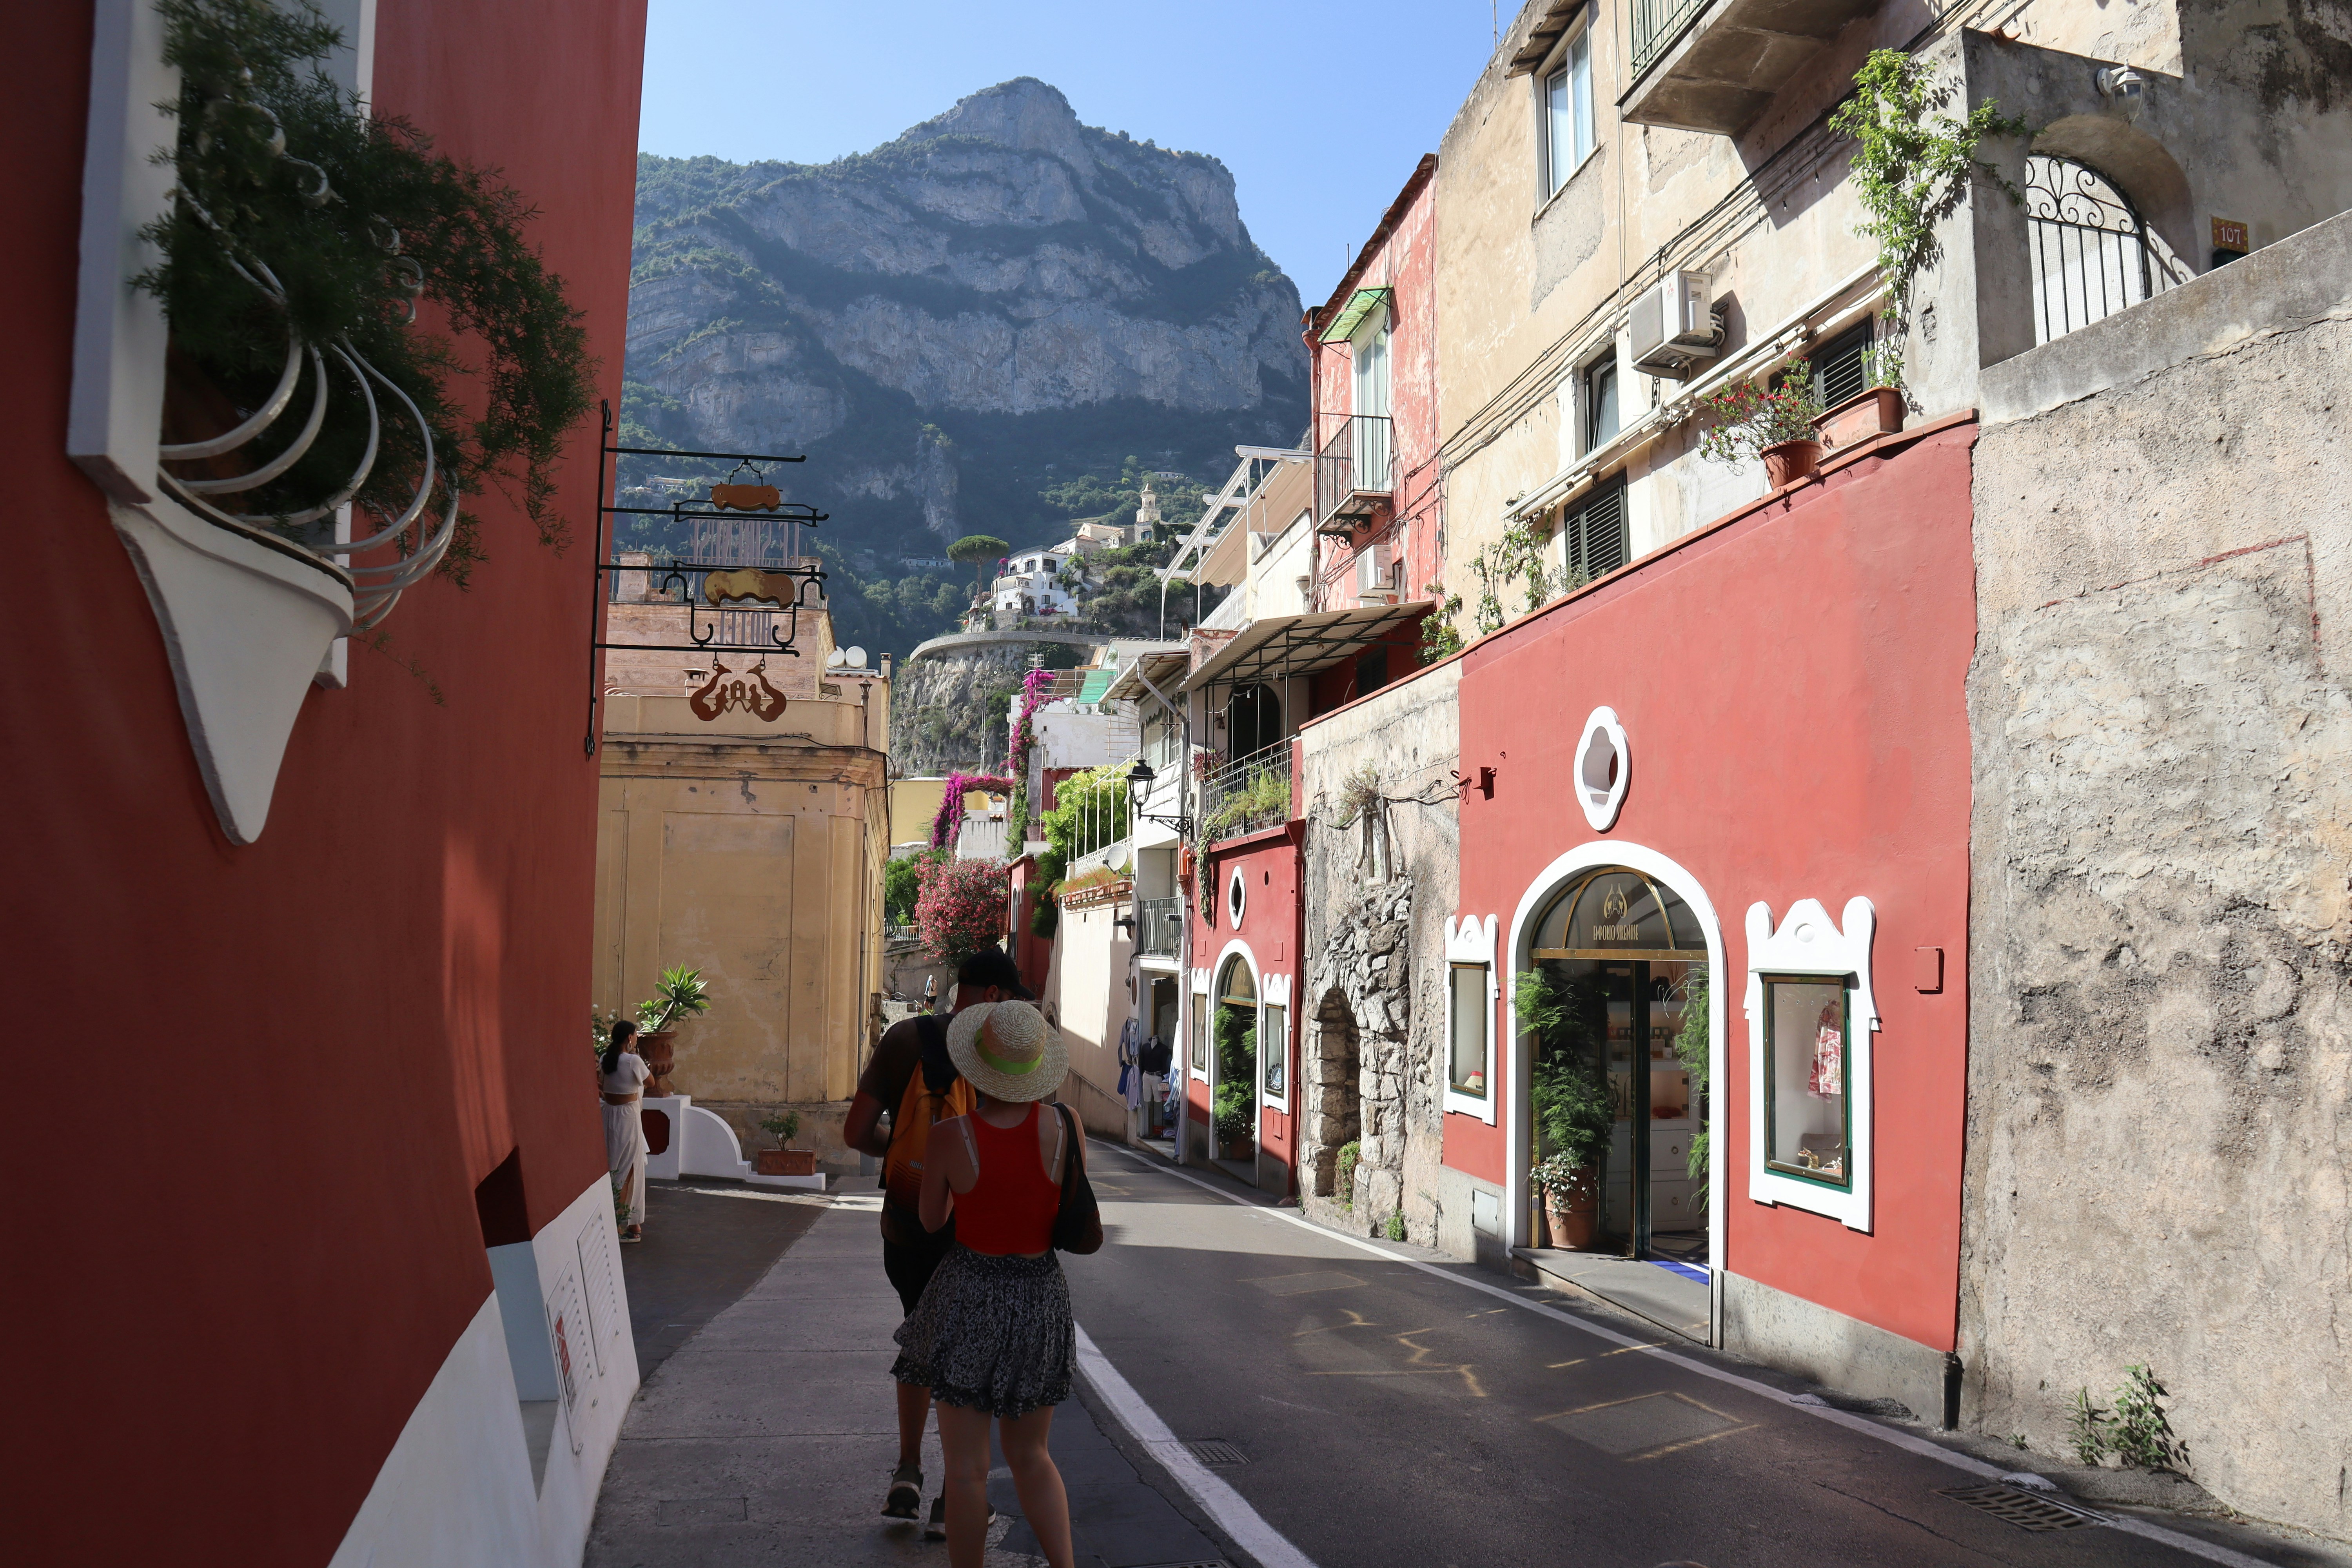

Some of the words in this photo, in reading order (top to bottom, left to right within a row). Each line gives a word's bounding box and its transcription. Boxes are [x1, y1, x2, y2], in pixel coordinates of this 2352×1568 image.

[2220, 227, 2240, 244] 107
[1593, 924, 1615, 941] EMPORIO
[1617, 924, 1639, 940] SIRENUSE
